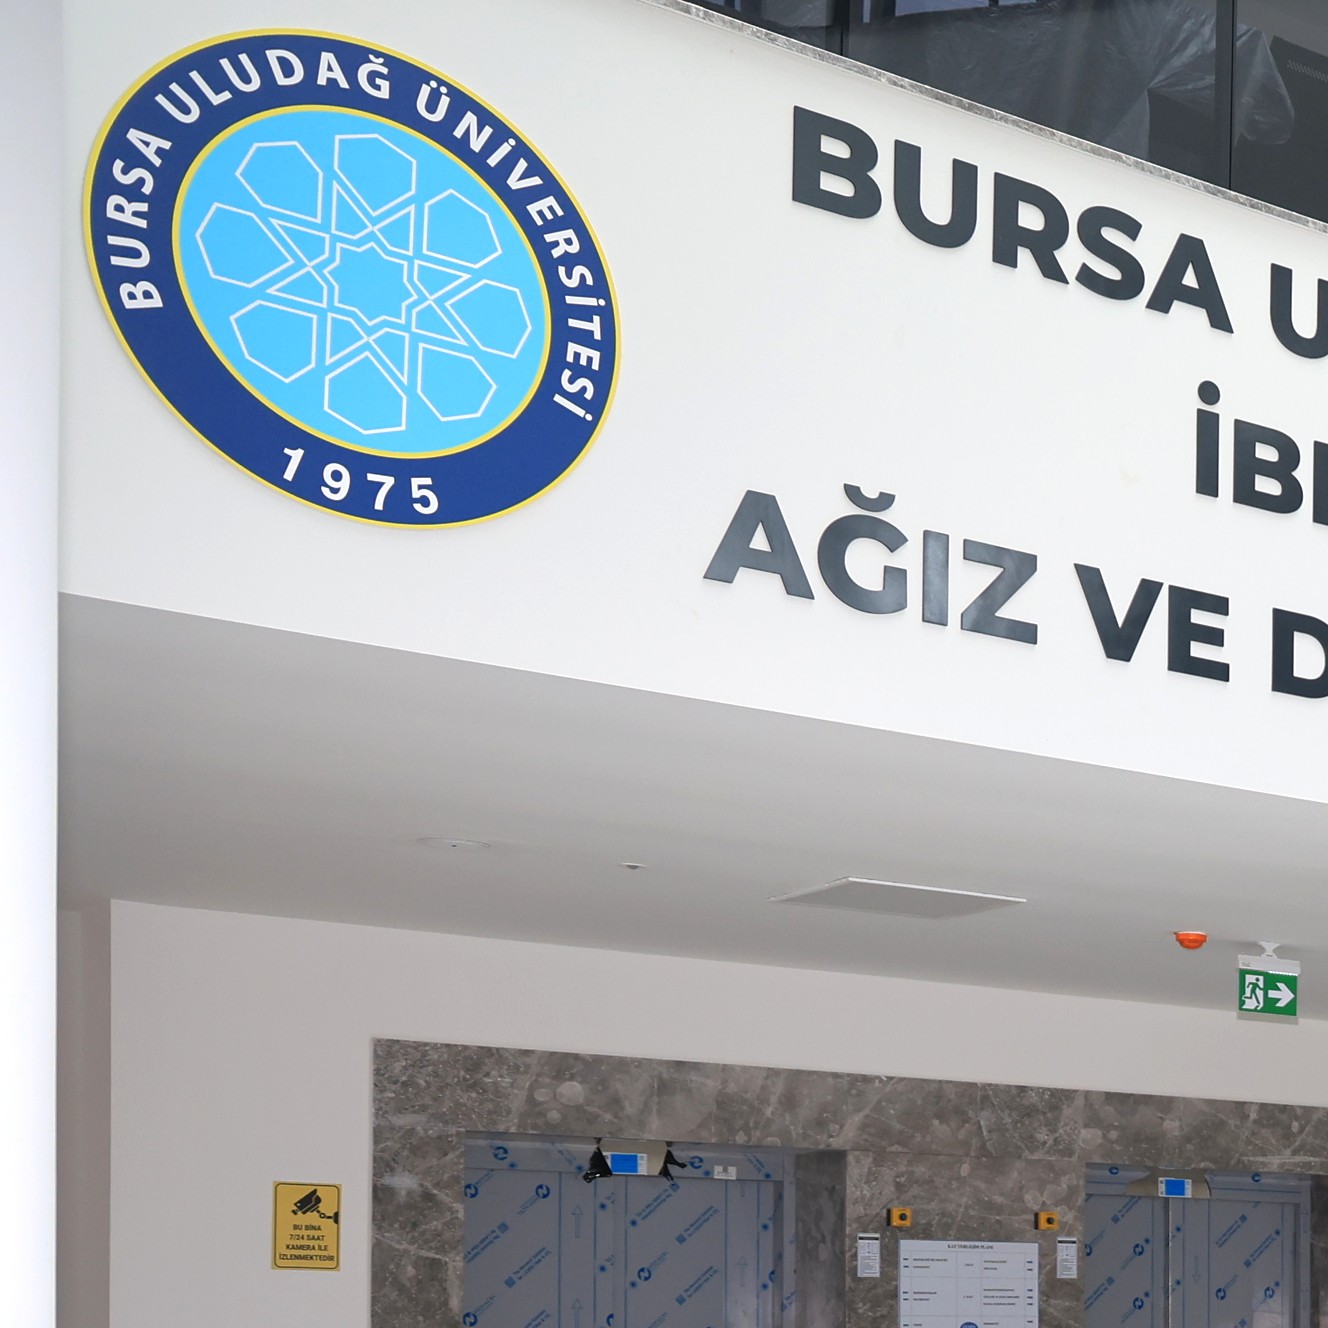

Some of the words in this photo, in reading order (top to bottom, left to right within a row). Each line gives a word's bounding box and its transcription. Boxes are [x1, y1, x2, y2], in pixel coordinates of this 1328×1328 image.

[105, 127, 172, 310] BURSA
[154, 47, 391, 124] ULUDAĞ
[415, 80, 606, 422] ÜNİVERSİTESİ
[792, 105, 1234, 334] BURSA
[281, 446, 440, 515] 1975
[703, 483, 1038, 645] AĞIZ
[1073, 562, 1231, 683] VE
[278, 1252, 335, 1261] İZLENMEKTEDİR
